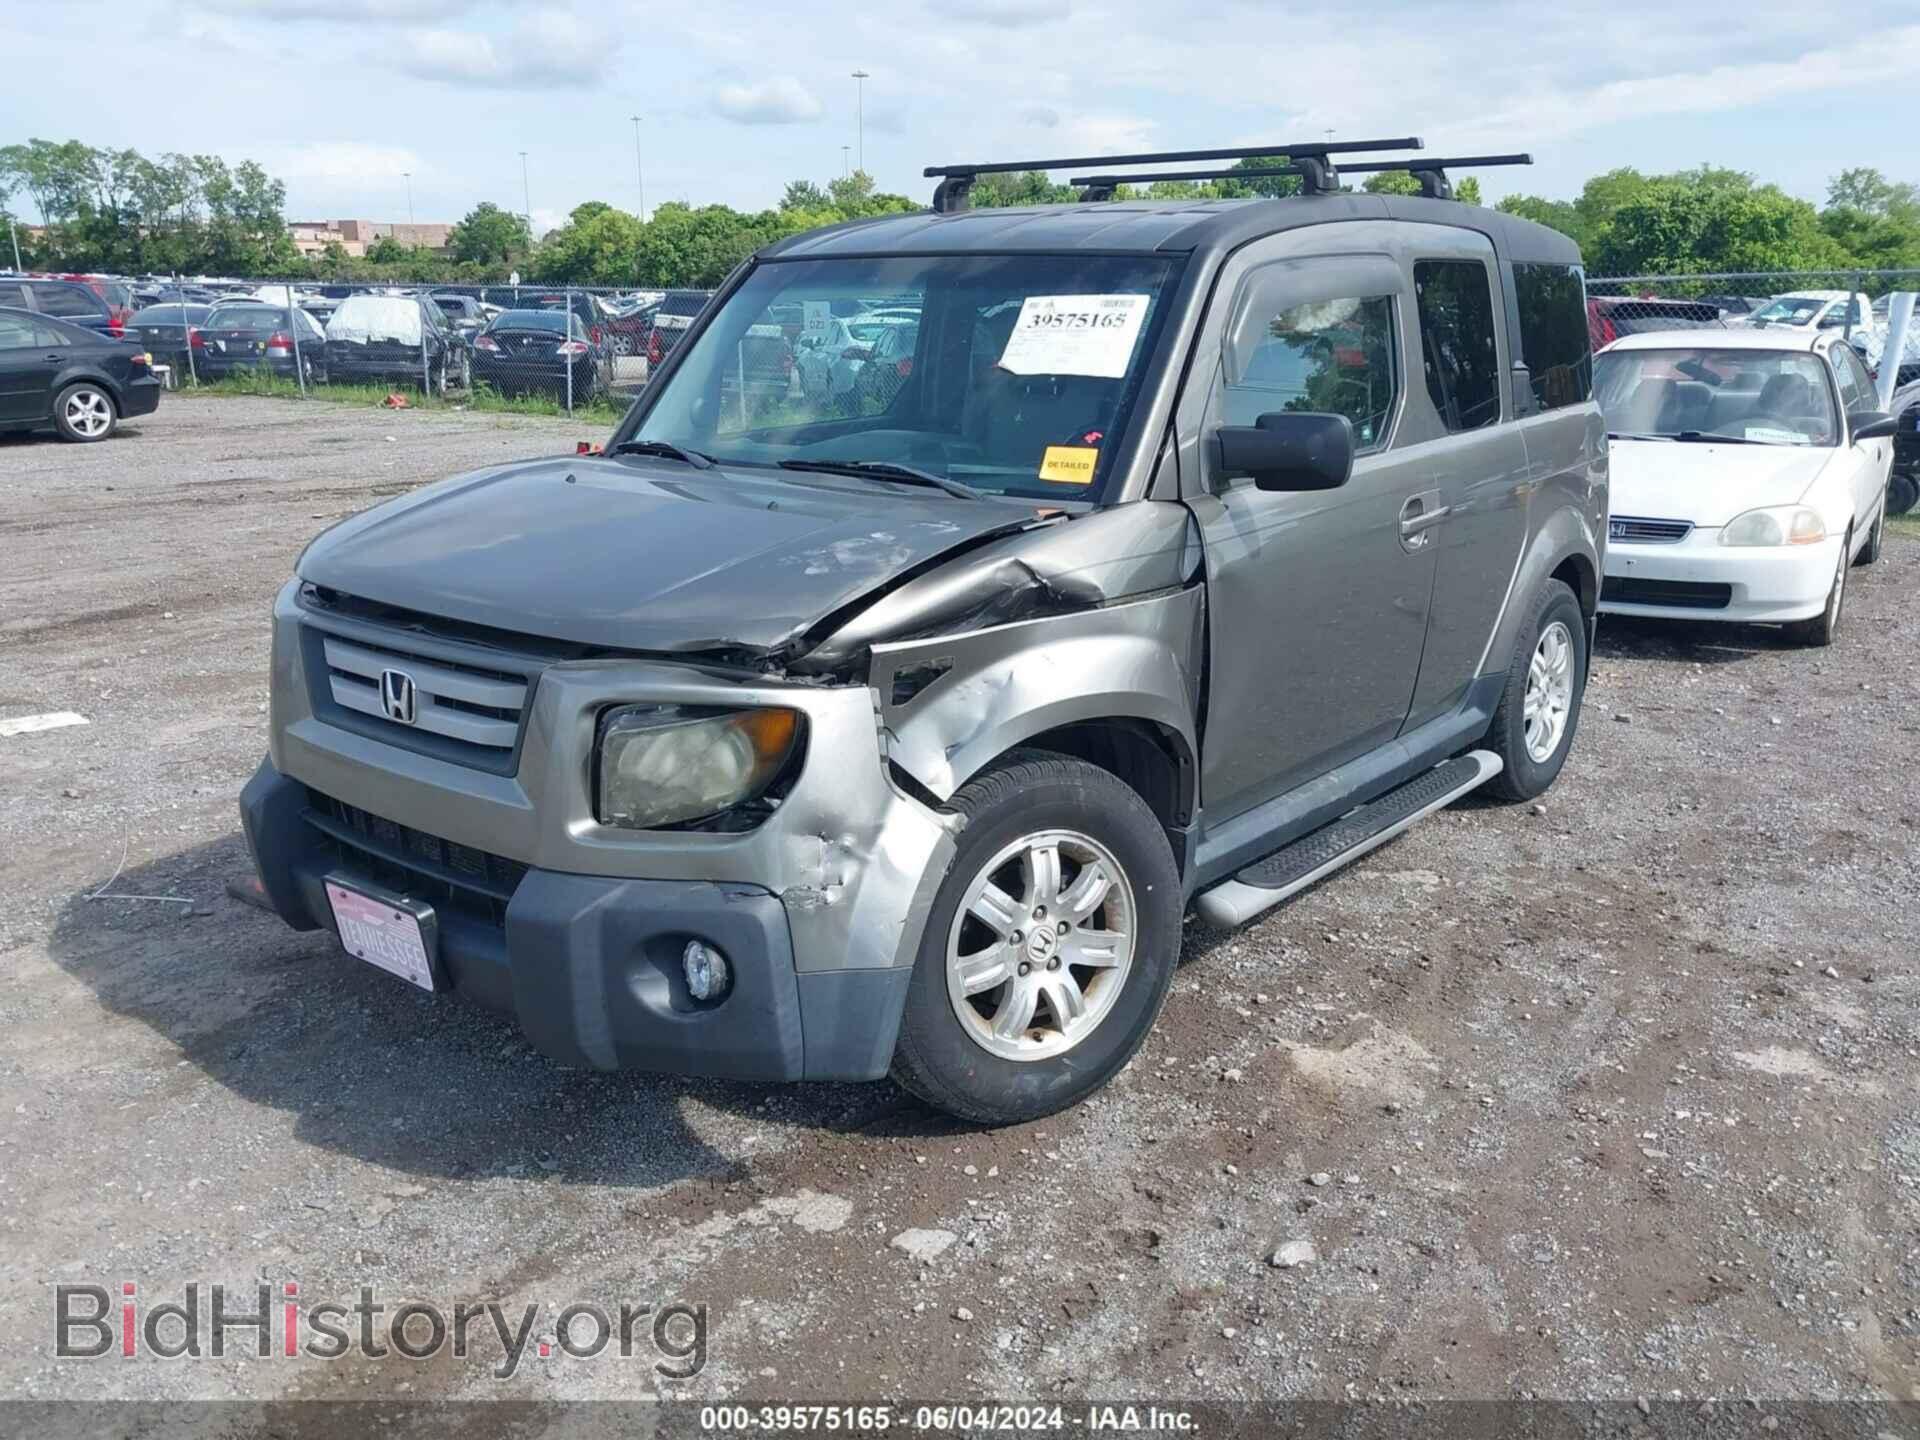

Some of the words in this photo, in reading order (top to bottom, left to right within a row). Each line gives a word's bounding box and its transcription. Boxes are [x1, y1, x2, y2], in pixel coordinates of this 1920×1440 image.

[1027, 312, 1128, 329] 39575165
[1047, 460, 1090, 470] DETAILED
[339, 917, 426, 974] TENNESSEE
